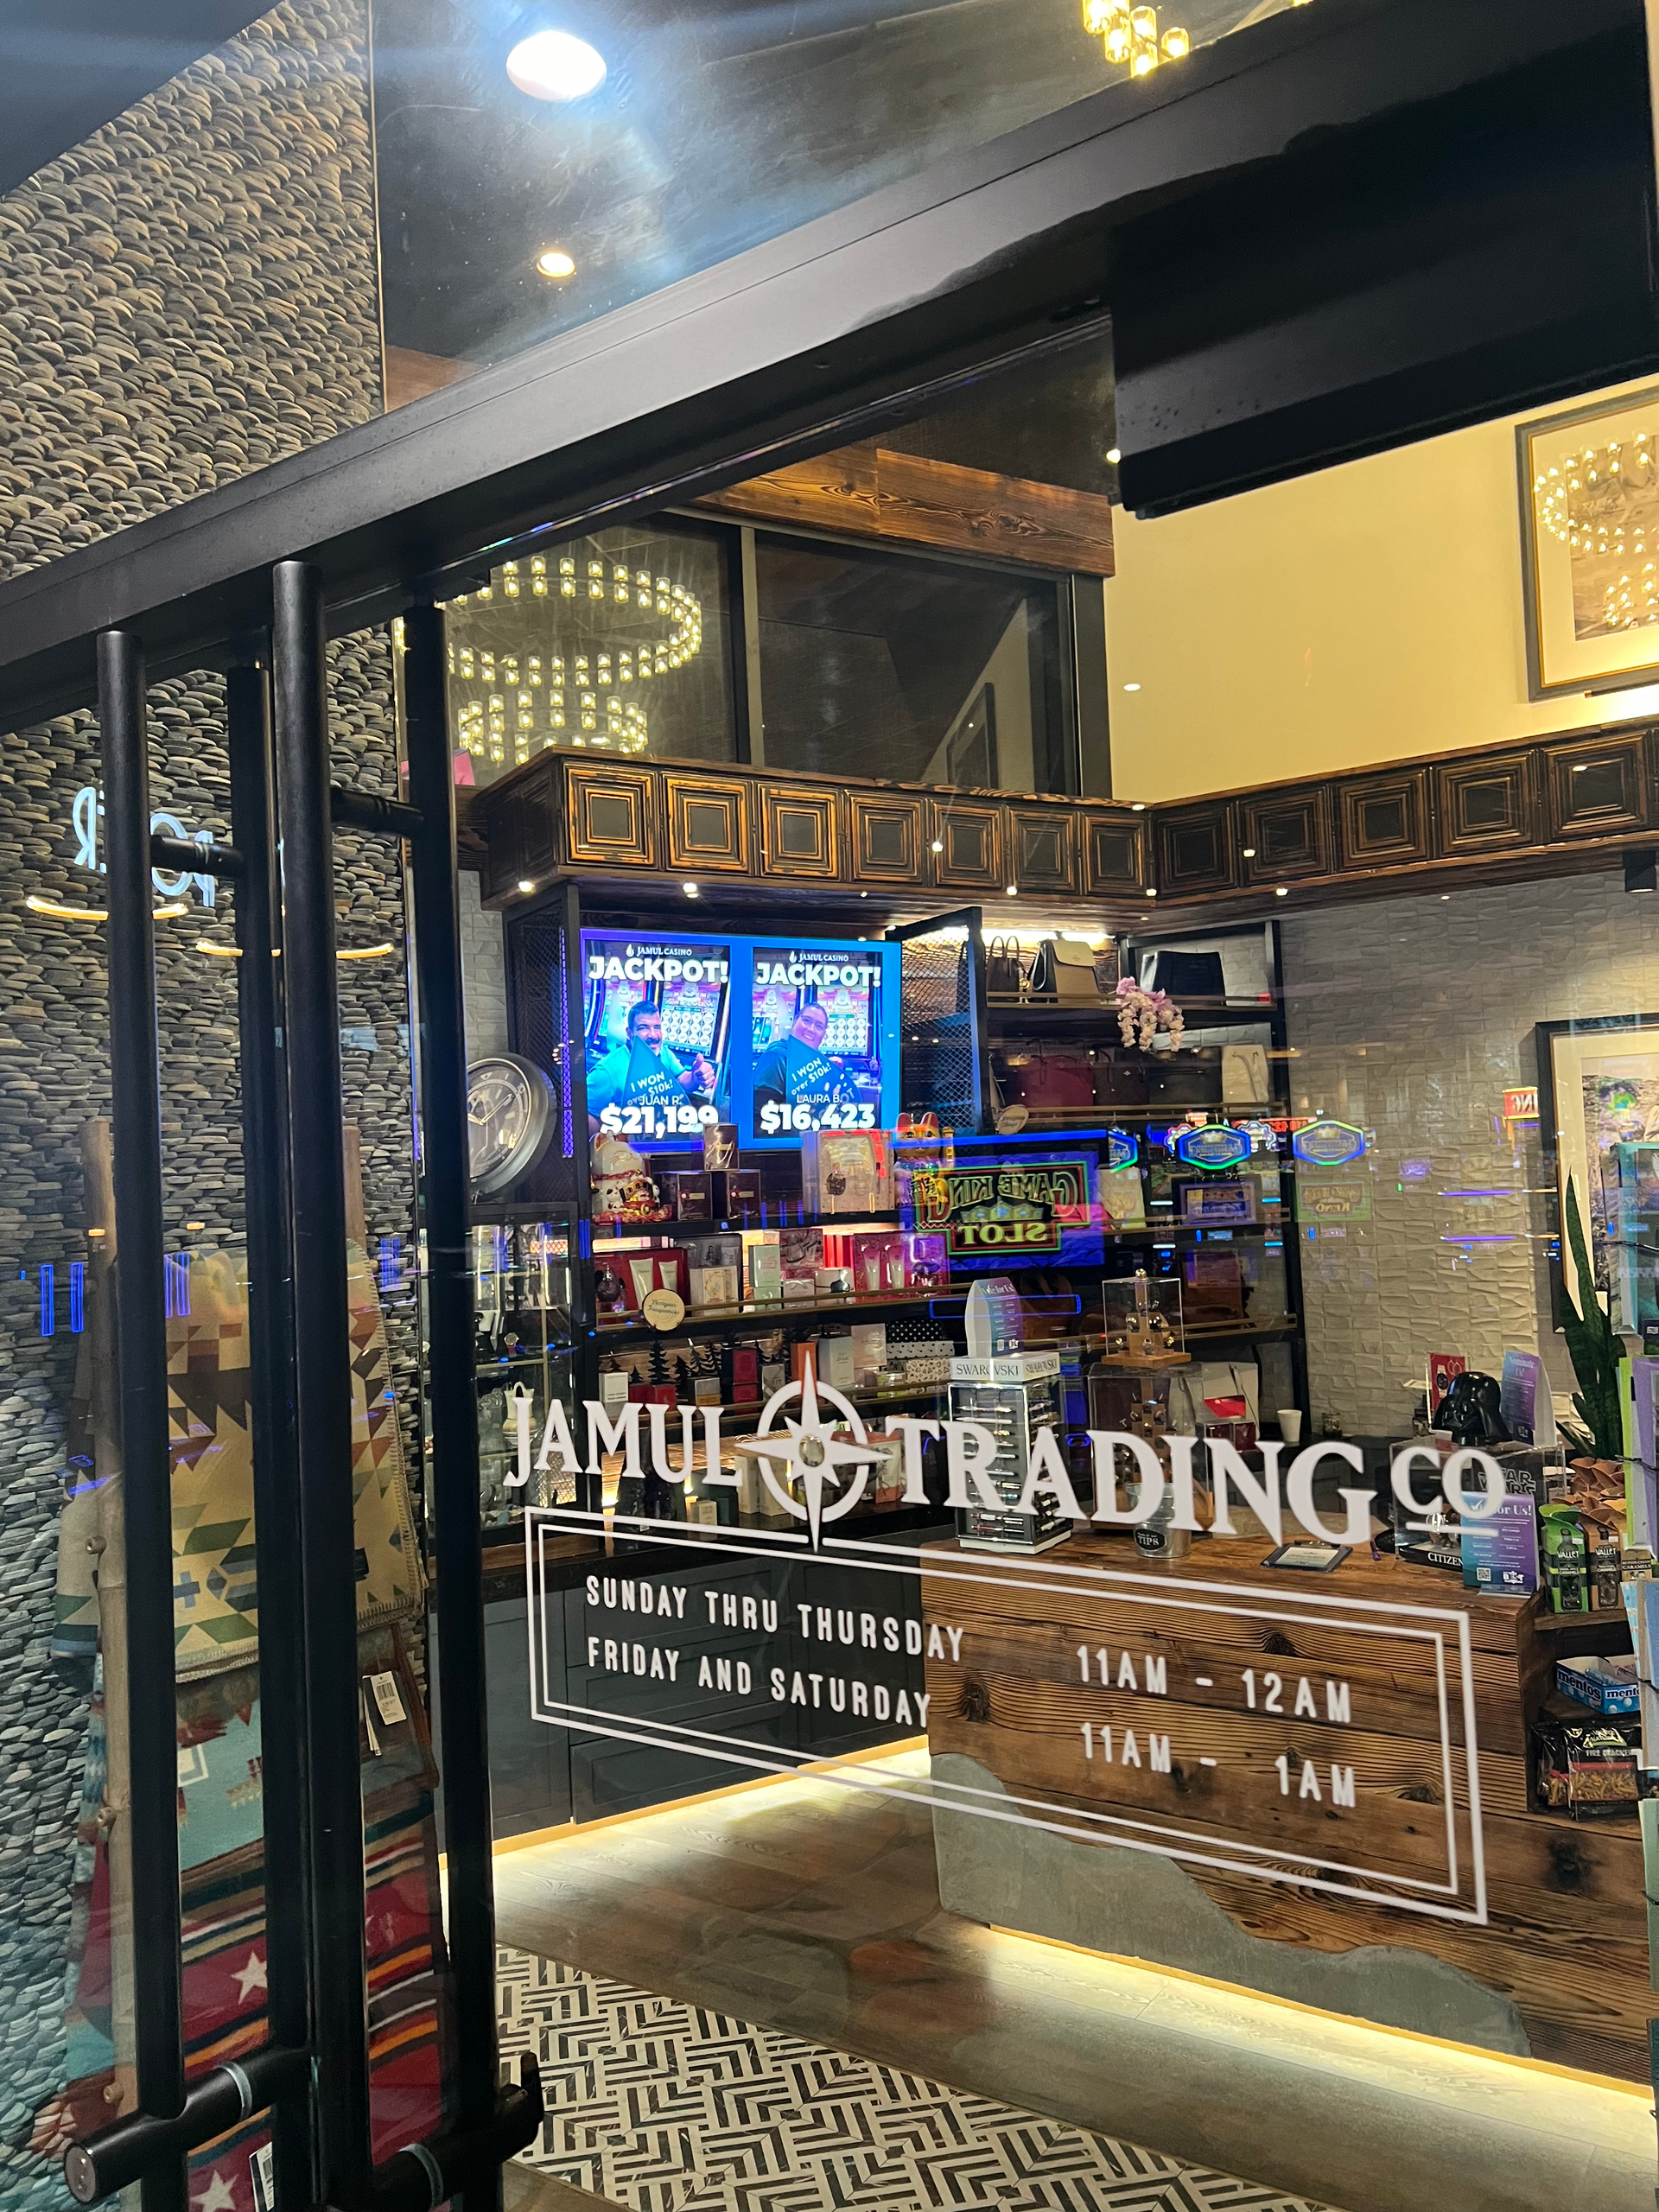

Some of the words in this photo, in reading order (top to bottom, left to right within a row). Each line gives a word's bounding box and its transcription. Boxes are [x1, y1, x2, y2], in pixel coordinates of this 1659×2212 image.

[636, 946, 664, 956] JAMUL
[664, 947, 692, 957] CASINO
[798, 952, 823, 962] JAMUL
[823, 953, 849, 962] CASINO
[588, 957, 729, 984] JACKPOT!
[755, 963, 881, 988] JACKPOT!
[791, 1073, 797, 1082] I
[797, 1057, 822, 1077] WON
[791, 1080, 808, 1096] over
[808, 1062, 831, 1083] $10k!
[631, 1083, 636, 1092] I
[637, 1071, 664, 1089] WON
[648, 1079, 673, 1096] $10k!
[639, 1096, 669, 1106] JUAN
[672, 1096, 682, 1106] R.
[797, 1094, 830, 1103] LAURA
[832, 1094, 842, 1103] B.
[600, 1105, 718, 1139] $21,199
[760, 1099, 875, 1132] $16,423
[957, 1363, 1020, 1376] SWAROVSKI
[503, 1397, 743, 1487] JAMUL
[886, 1417, 1378, 1546] TRADING
[1391, 1446, 1505, 1519] CO
[1514, 1504, 1532, 1516] Us!
[1137, 1535, 1159, 1545] TIPS
[1427, 1553, 1464, 1566] CITIZEN
[586, 1575, 687, 1619] SUNDAY
[704, 1590, 778, 1633] THRU
[798, 1604, 963, 1662] THURSDAY
[1077, 1644, 1168, 1695] 11AM
[1557, 1669, 1602, 1701] mentos
[1606, 1688, 1640, 1699] ment
[588, 1637, 679, 1682] FRIDAY
[698, 1656, 752, 1695] AND
[771, 1667, 931, 1728] SATURDAY
[1079, 1723, 1172, 1774] 11AM
